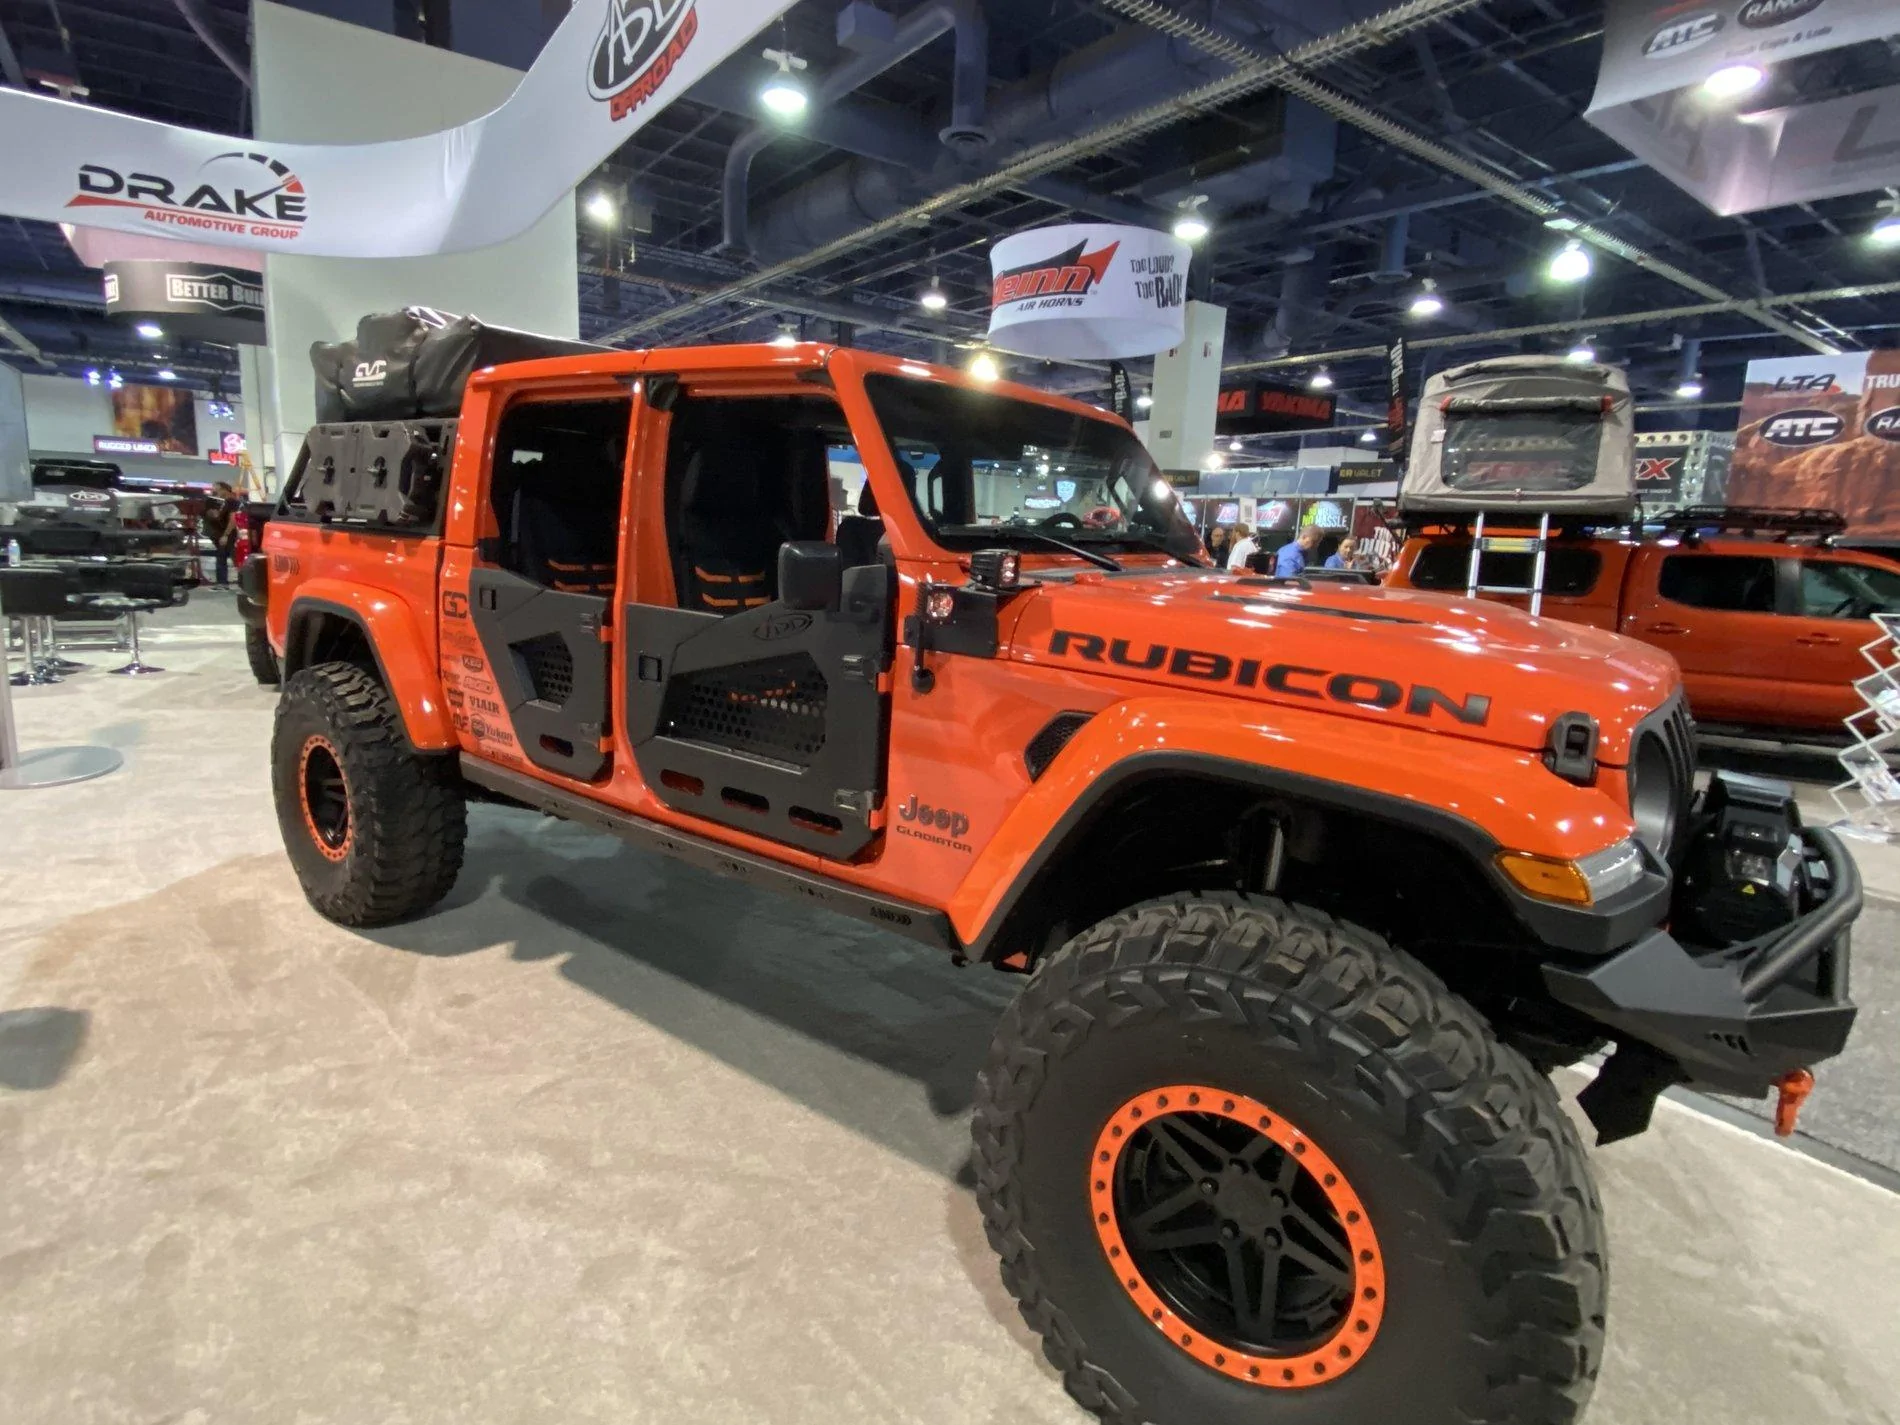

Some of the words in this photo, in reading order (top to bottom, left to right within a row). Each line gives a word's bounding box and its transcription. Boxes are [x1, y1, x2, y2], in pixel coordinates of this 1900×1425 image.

[609, 5, 698, 122] OFFROAD
[78, 163, 308, 222] DRAKE
[144, 210, 246, 235] AUTOMOTIVE
[250, 225, 299, 240] GROUP
[171, 278, 229, 301] BETTER
[1016, 300, 1037, 312] AIR
[1038, 297, 1085, 309] HORNS
[1775, 373, 1837, 393] LTA
[1764, 417, 1838, 438] ATC
[1047, 629, 1492, 728] RUBICON
[470, 695, 500, 714] VIAIR
[899, 793, 970, 839] Jeep
[896, 825, 973, 854] GLADIATOR
